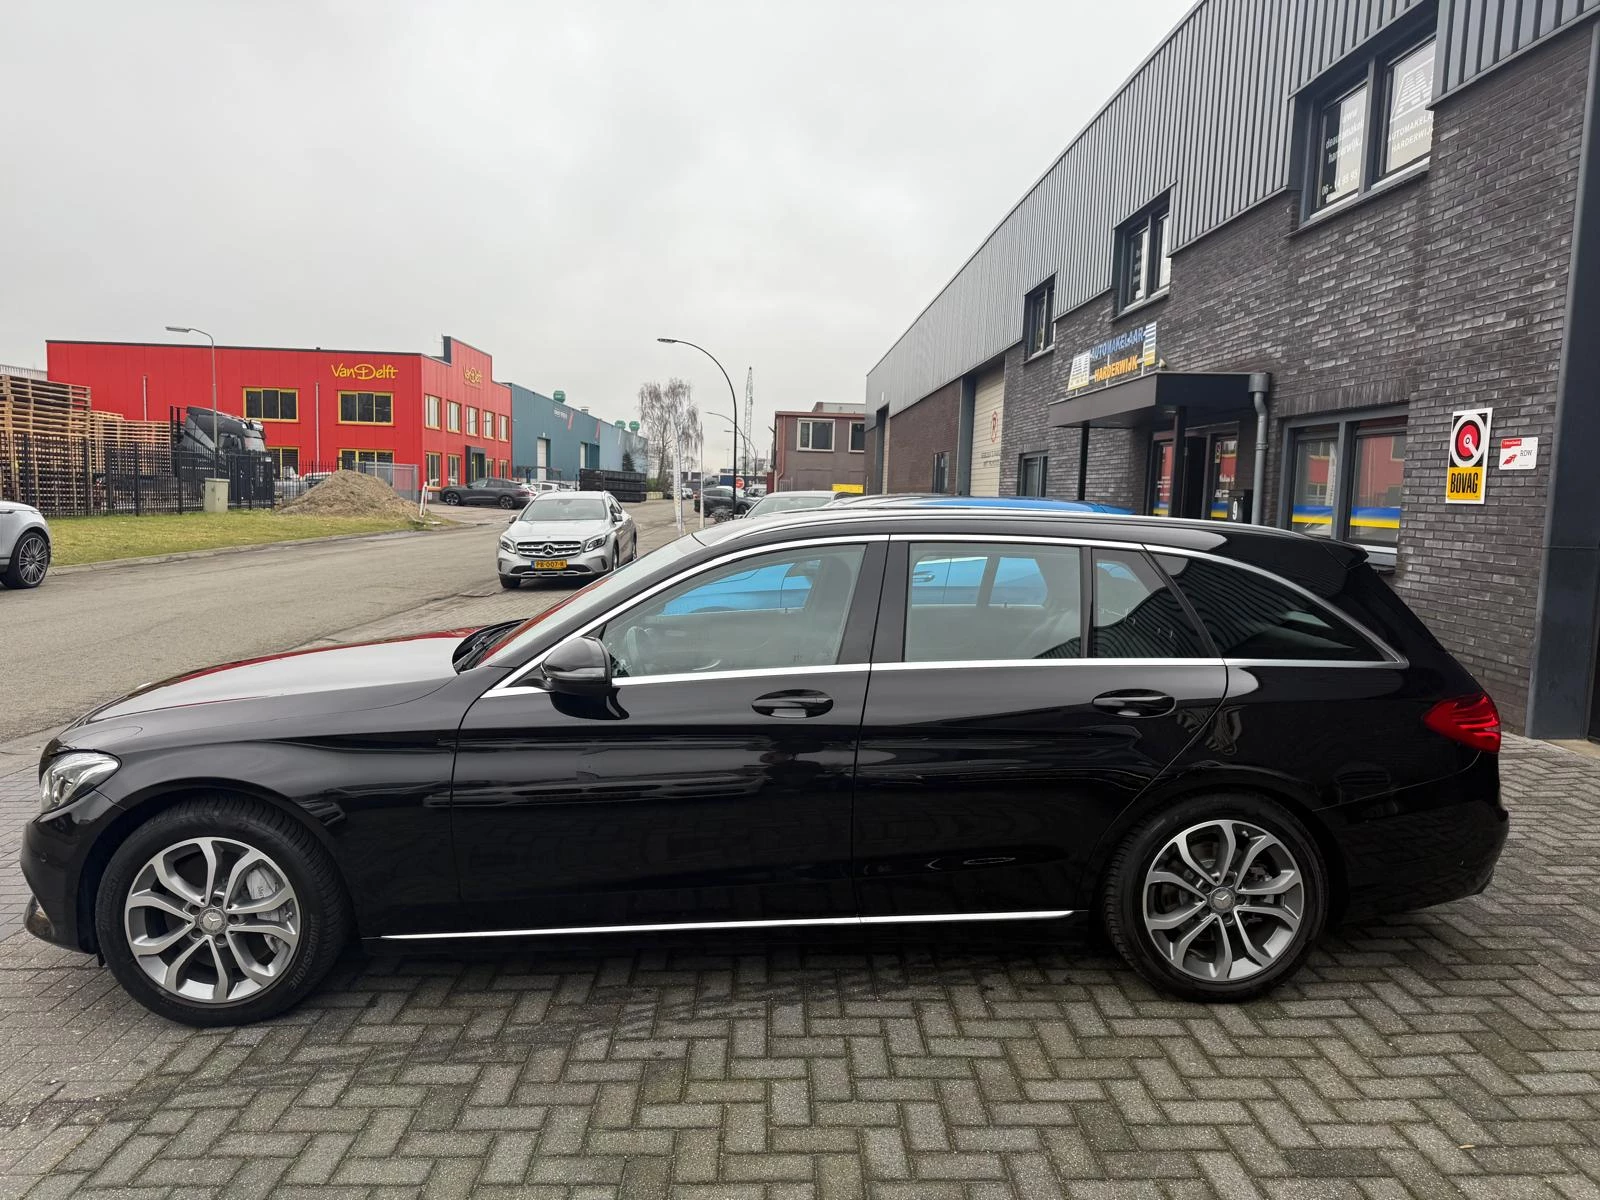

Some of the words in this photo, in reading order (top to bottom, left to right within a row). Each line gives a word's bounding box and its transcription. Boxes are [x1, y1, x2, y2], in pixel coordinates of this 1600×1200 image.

[1091, 327, 1144, 359] AUTOMAKELAAR
[1094, 355, 1138, 382] HARDERWIJK
[1450, 472, 1479, 494] BOVAG
[1232, 501, 1238, 520] 9
